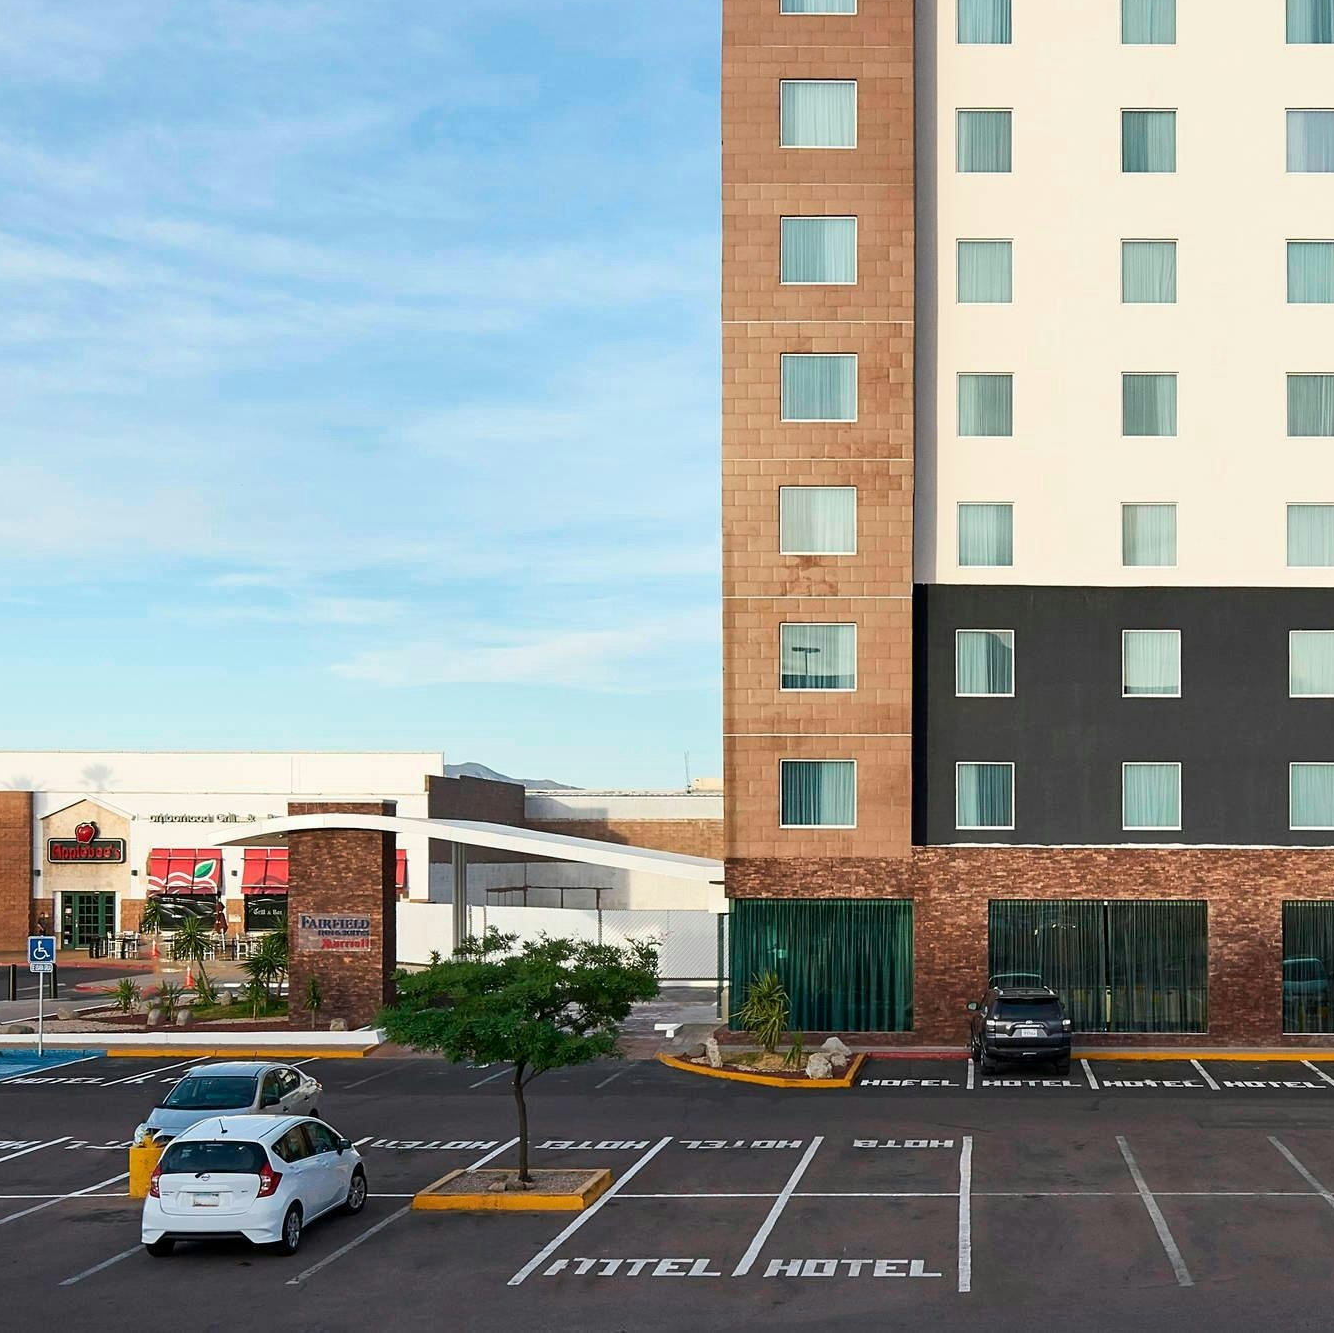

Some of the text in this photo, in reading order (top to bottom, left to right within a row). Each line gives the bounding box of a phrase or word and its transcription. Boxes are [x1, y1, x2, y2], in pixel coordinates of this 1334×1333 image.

[52, 843, 122, 859] Applebee's
[301, 915, 370, 930] FAIRFIELD
[982, 1079, 1082, 1087] HOTEL
[1102, 1079, 1204, 1087] HOTEL
[1222, 1080, 1327, 1088] HOTEL
[764, 1258, 943, 1278] HOTEL
